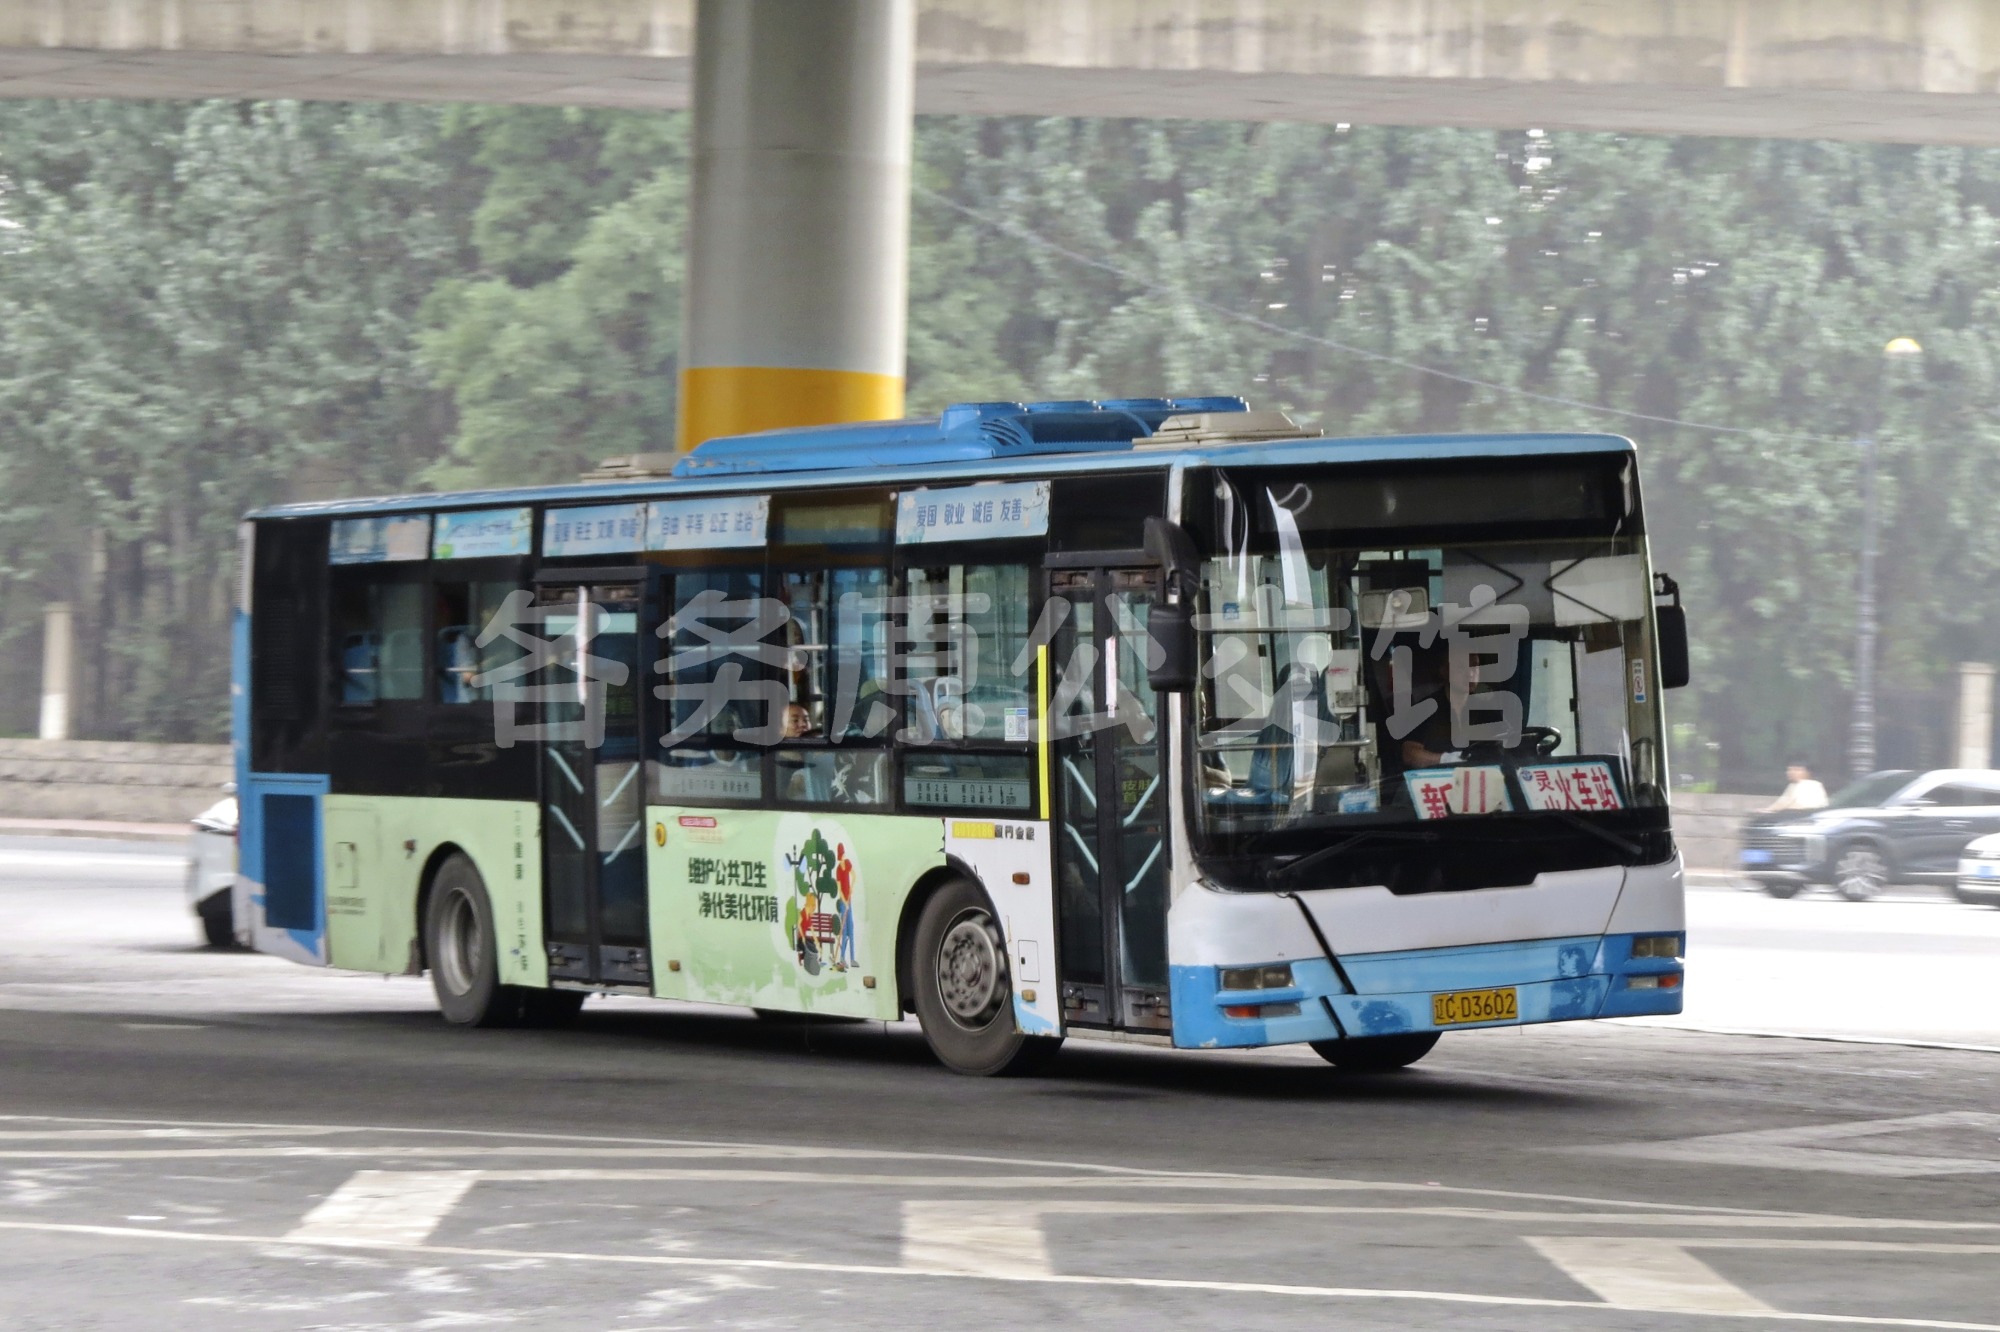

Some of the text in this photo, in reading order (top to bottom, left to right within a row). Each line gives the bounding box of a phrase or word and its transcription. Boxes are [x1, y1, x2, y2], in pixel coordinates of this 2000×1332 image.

[917, 498, 1022, 528] 爱国 敬业 诚信 友善
[688, 857, 767, 888] 维护公共卫生
[699, 891, 779, 923] 净化美化环境
